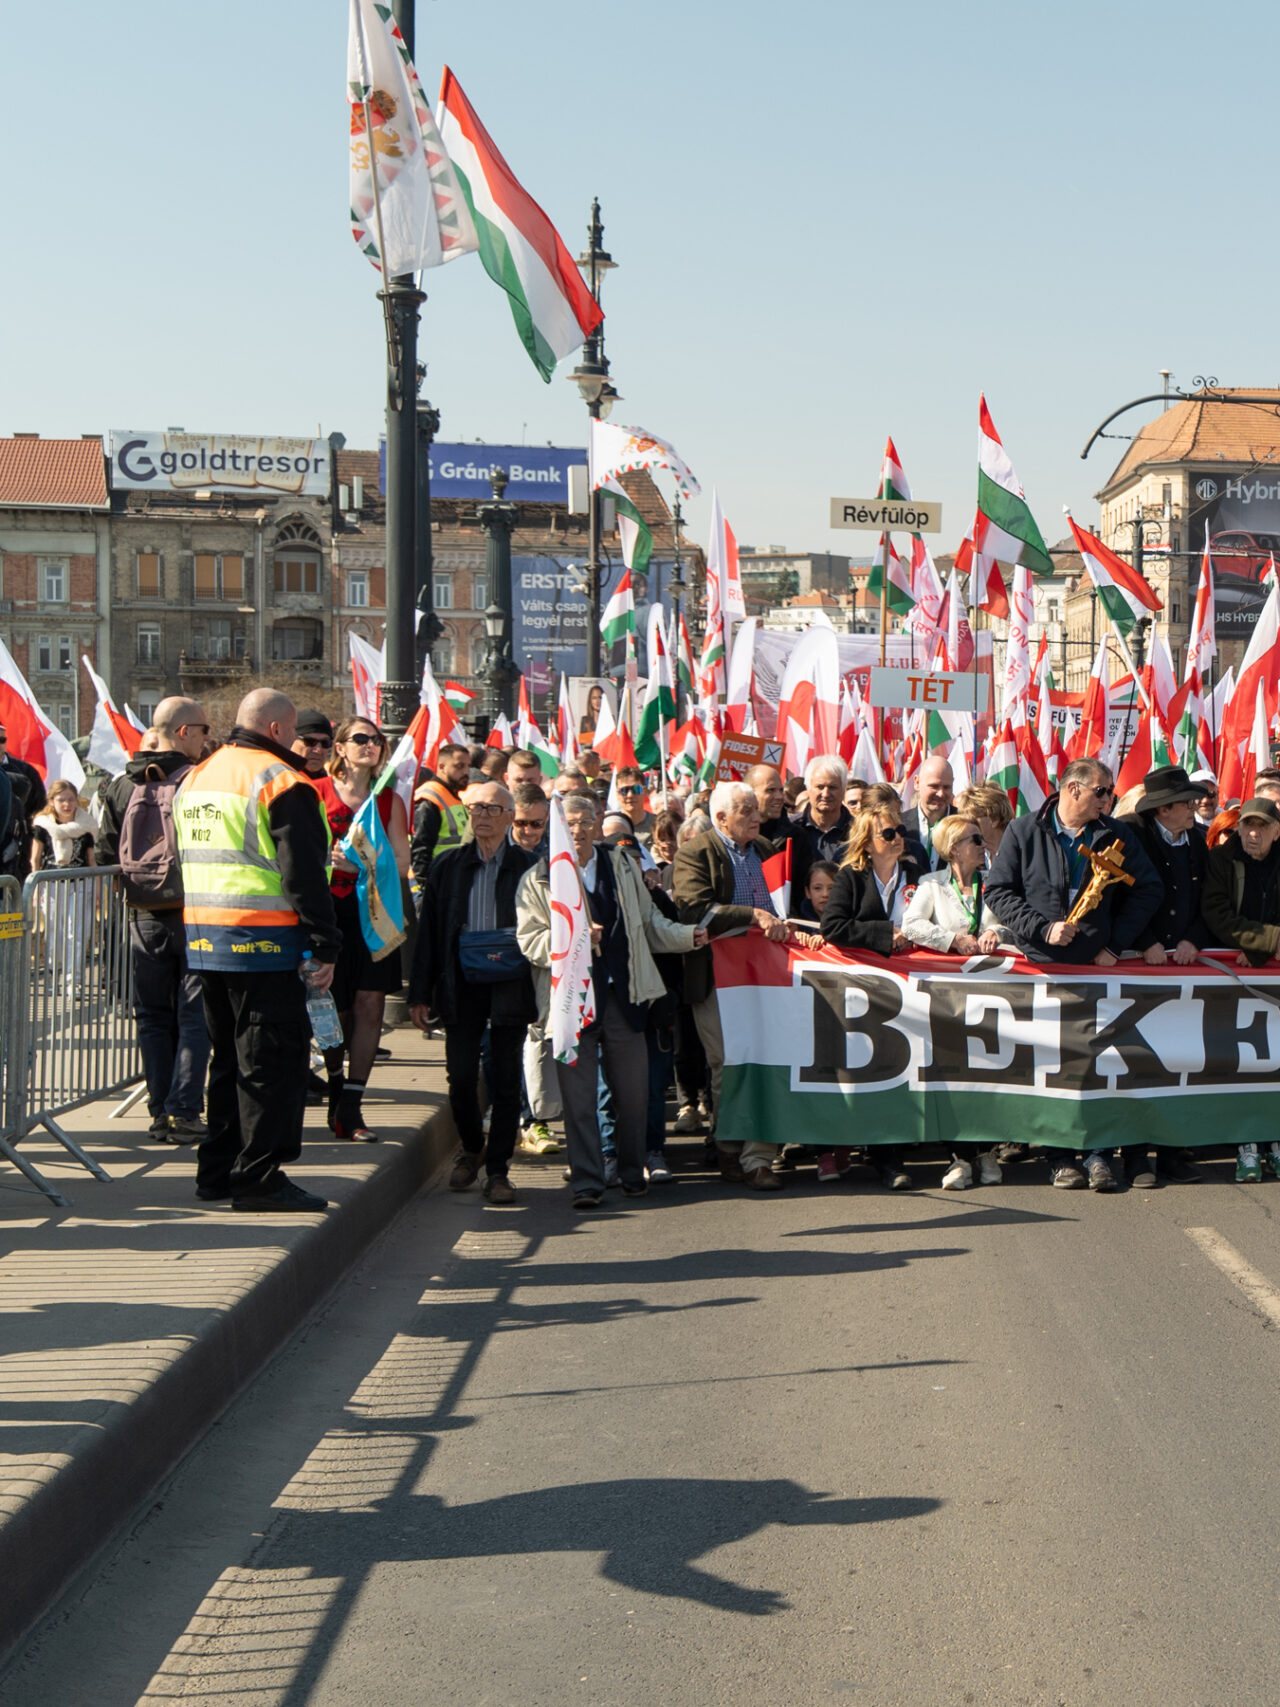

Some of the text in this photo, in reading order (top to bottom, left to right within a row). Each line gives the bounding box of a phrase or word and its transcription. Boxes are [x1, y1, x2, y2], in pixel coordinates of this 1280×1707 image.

[160, 447, 325, 475] goldtresor
[440, 462, 504, 480] Gráni
[510, 465, 561, 483] Bank
[843, 505, 929, 528] Révfülöp
[1217, 612, 1232, 622] HS
[907, 672, 954, 704] TÉT
[723, 740, 759, 756] FIDESZ
